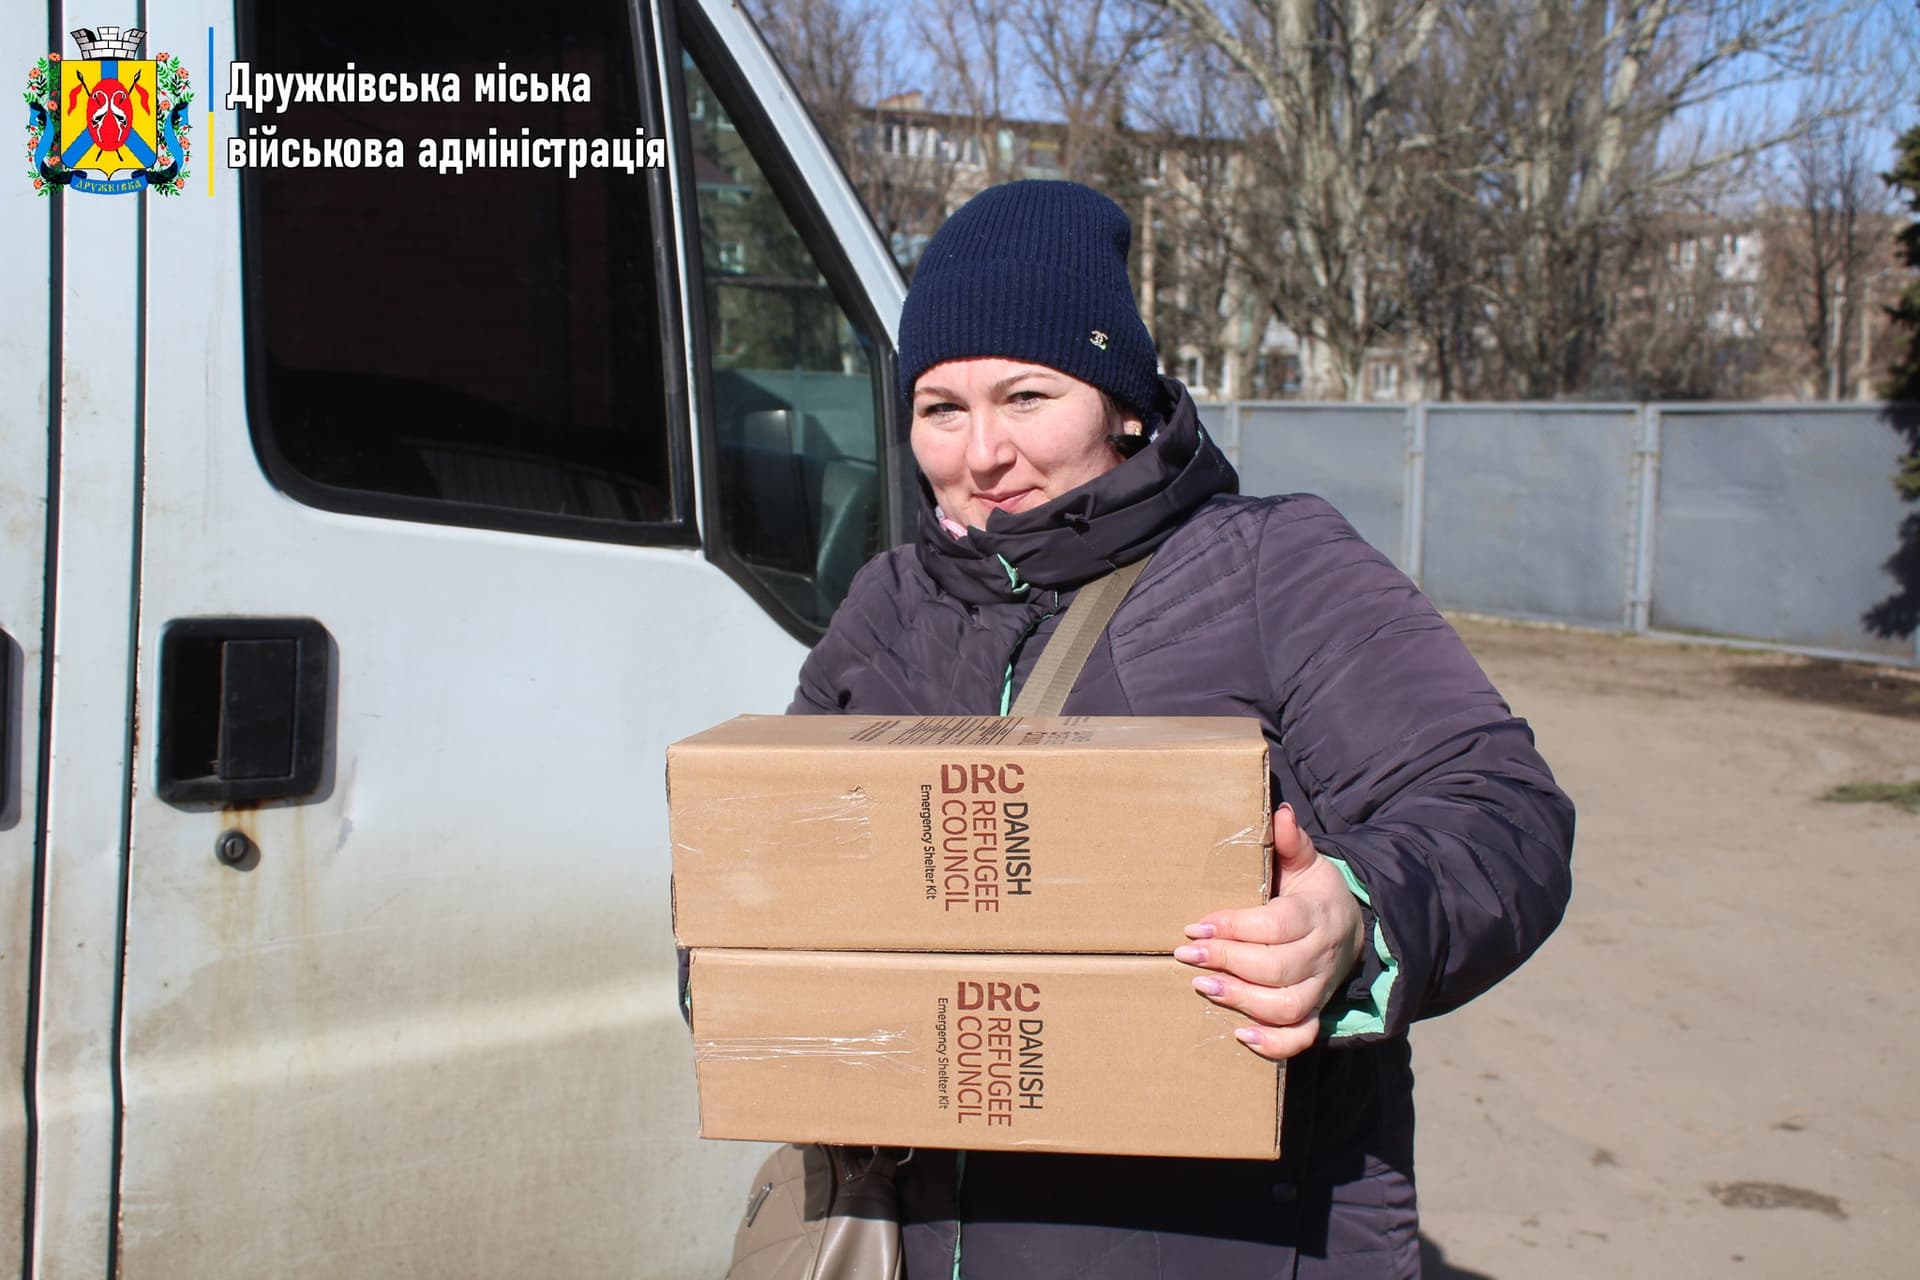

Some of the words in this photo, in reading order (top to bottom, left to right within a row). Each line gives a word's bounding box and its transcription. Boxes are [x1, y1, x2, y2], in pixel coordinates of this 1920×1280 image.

[941, 763, 1025, 794] DRC
[919, 784, 932, 844] Emergency
[923, 846, 936, 884] Shelter
[941, 800, 969, 912] COUNCIL
[971, 800, 999, 913] REFUGEE
[1003, 802, 1032, 895] DANISH
[925, 885, 937, 900] Kit
[935, 997, 949, 1055] Emergency
[957, 981, 1041, 1012] DRC
[938, 1057, 949, 1095] Shelter
[957, 1015, 982, 1124] COUNCIL
[987, 1017, 1012, 1127] REFUGEE
[1018, 1019, 1043, 1110] DANISH
[938, 1095, 949, 1110] Kit
